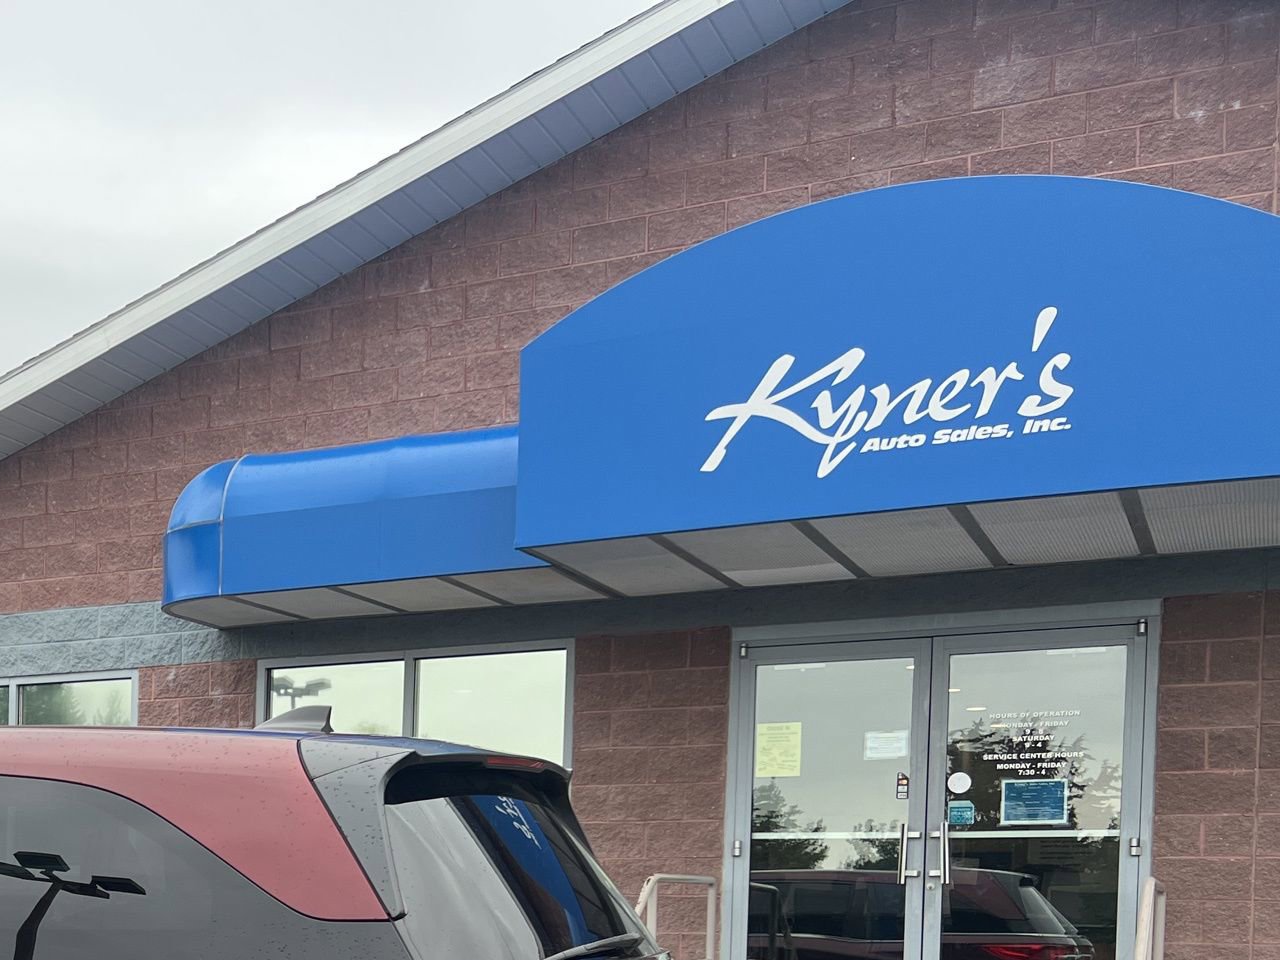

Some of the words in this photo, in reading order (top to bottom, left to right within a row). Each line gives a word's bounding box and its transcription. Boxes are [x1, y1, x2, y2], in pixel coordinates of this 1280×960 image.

[700, 306, 1074, 479] Kyner's
[860, 433, 927, 453] Auto
[932, 423, 1014, 446] Sales,
[1022, 416, 1072, 435] Inc.
[989, 711, 1018, 719] HOURS
[1033, 710, 1081, 718] OPERATION
[983, 753, 1018, 761] SERVICE
[1020, 752, 1054, 760] CENTER
[996, 762, 1032, 770] MONDAY
[1037, 761, 1067, 769] FRIDAY
